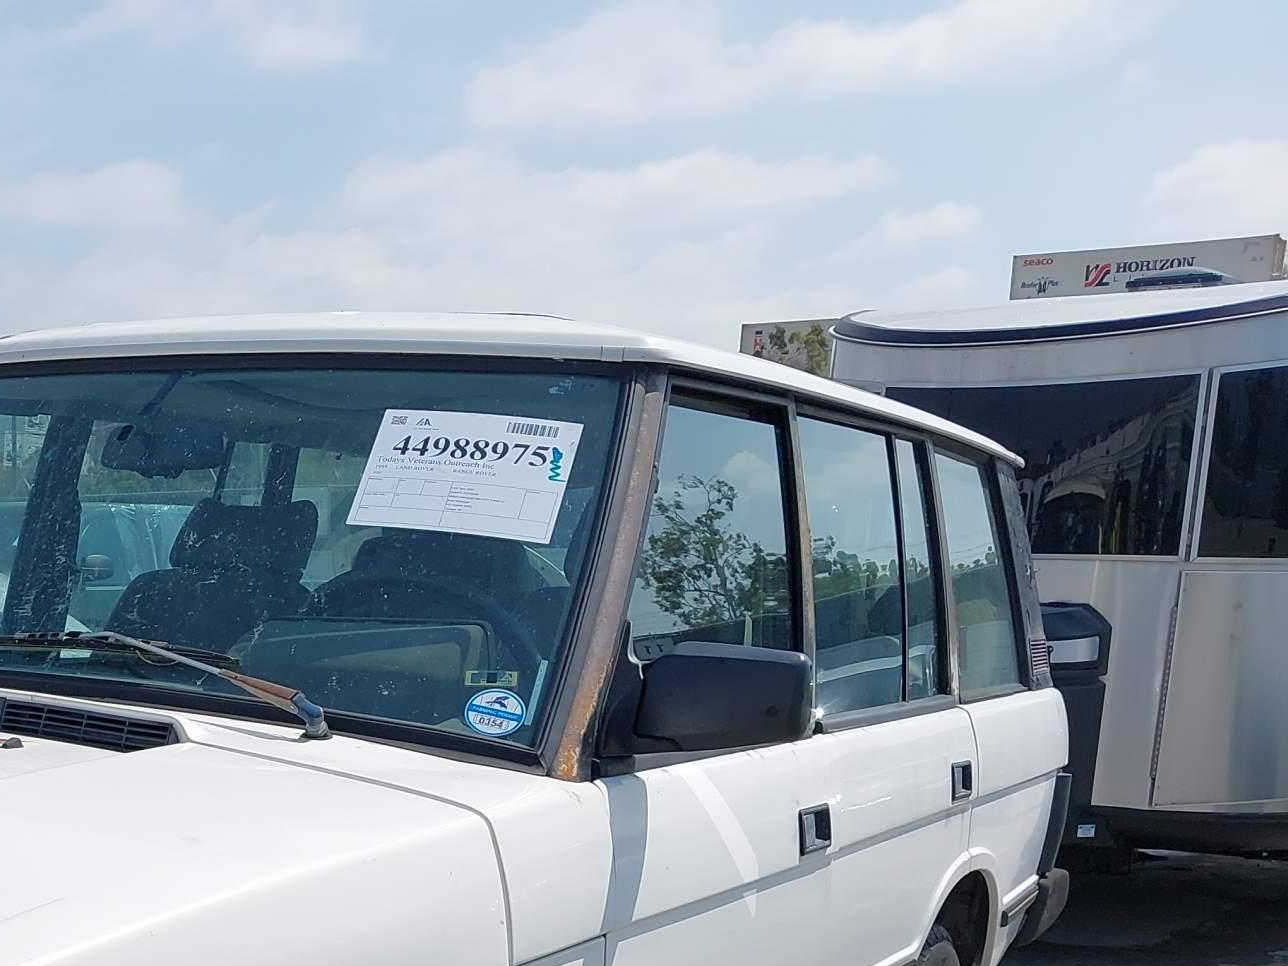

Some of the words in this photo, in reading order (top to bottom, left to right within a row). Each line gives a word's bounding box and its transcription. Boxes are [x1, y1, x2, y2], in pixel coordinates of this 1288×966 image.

[1114, 256, 1196, 274] HORIZON
[392, 434, 551, 467] 44988975
[377, 455, 405, 465] Todays
[408, 456, 441, 466] Veterans
[444, 459, 480, 468] Outreach
